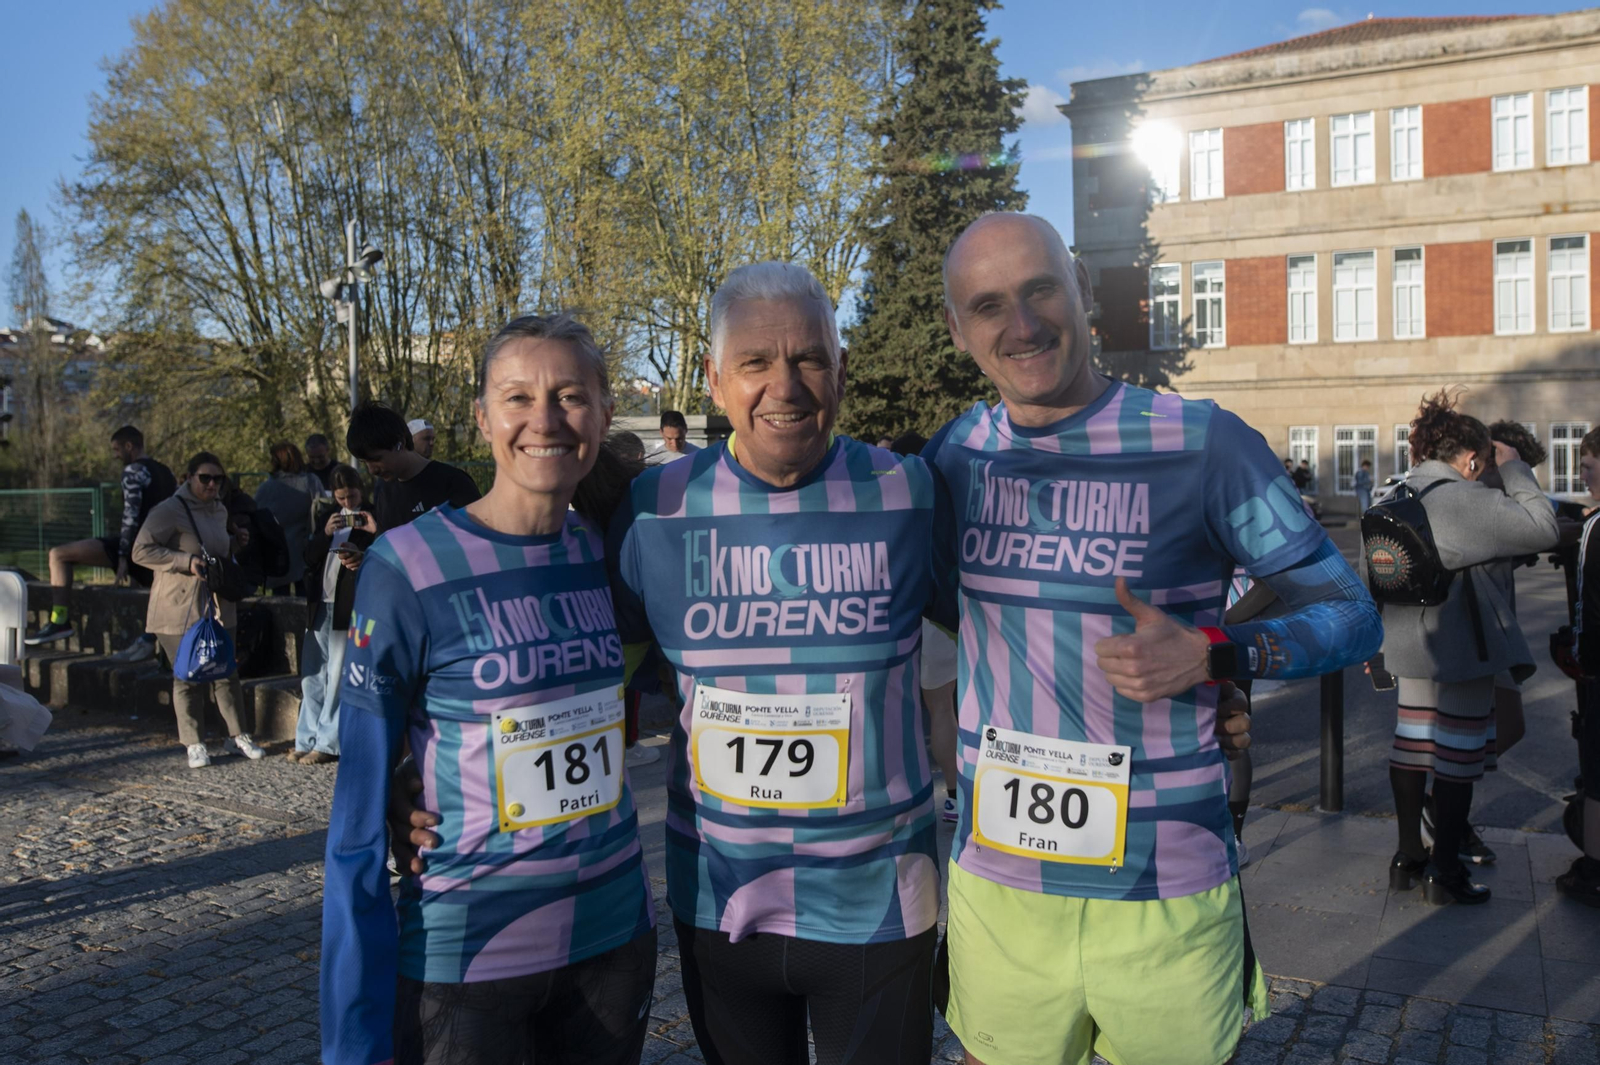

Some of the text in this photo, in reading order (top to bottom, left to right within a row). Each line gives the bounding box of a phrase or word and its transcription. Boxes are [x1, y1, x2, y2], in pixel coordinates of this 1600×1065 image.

[962, 527, 1148, 577] OURENSE
[683, 596, 892, 640] OURENSE
[472, 633, 625, 690] OURENS
[548, 711, 571, 722] PONTE
[573, 706, 593, 715] VELLA
[700, 710, 741, 724] OURENSE
[774, 706, 799, 714] VELLA
[501, 728, 546, 745] OURENSE
[726, 736, 815, 778] 179
[985, 749, 1019, 765] OURENSE
[1023, 745, 1046, 757] PONTE
[1048, 750, 1073, 761] VELLA
[533, 735, 611, 792] 181
[559, 789, 600, 813] Patri
[750, 785, 783, 800] Rua
[1003, 777, 1089, 830] 180
[1019, 832, 1058, 851] Fran
